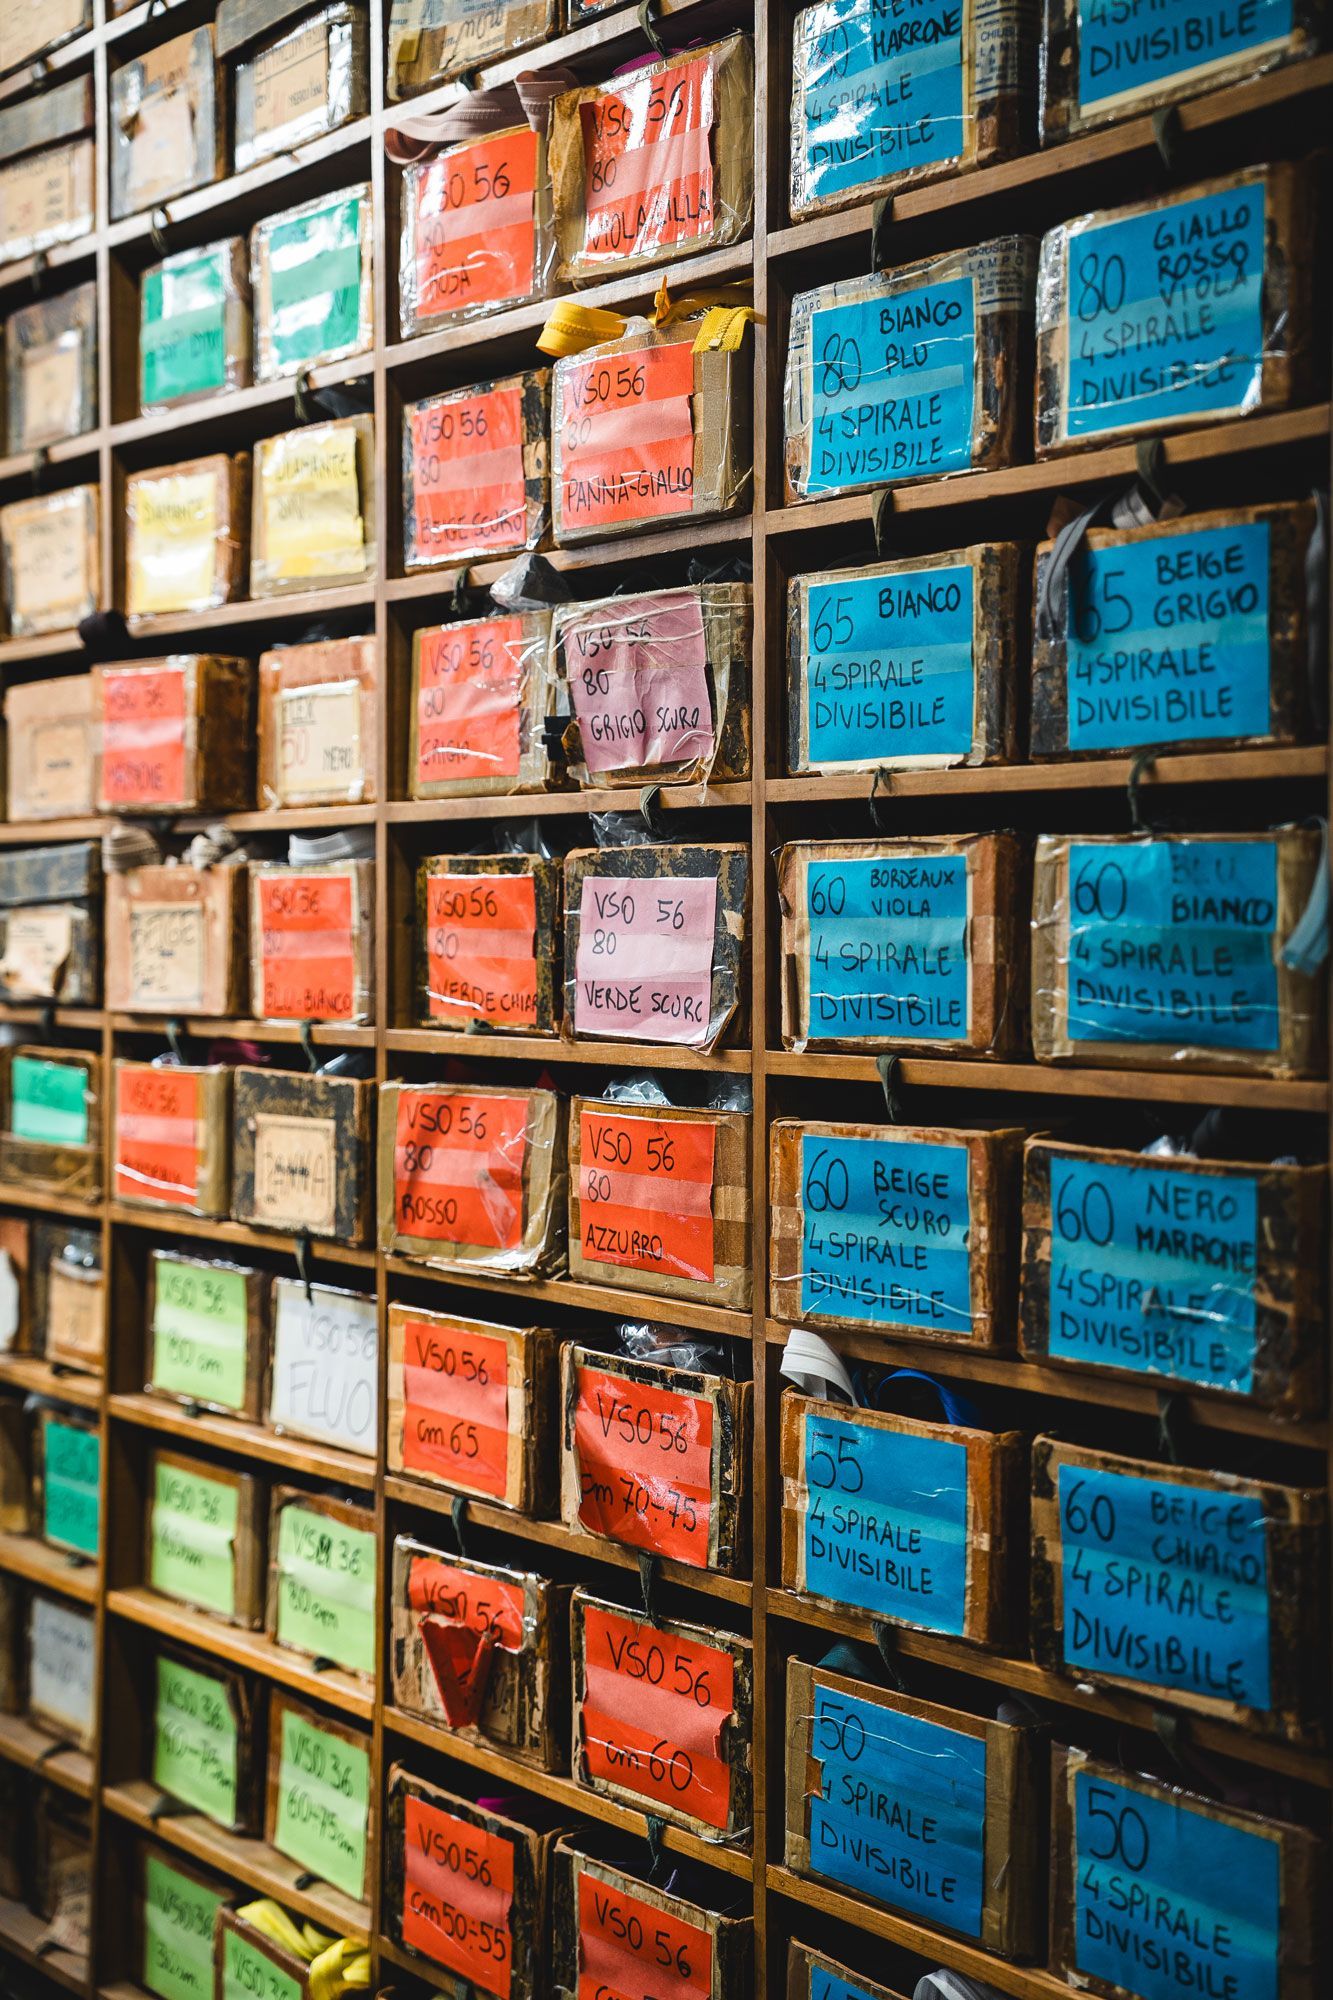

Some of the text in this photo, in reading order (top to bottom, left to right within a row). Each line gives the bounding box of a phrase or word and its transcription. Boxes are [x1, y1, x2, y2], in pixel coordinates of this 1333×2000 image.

[872, 8, 961, 62] MARRONE
[1090, 2, 1257, 77] DIVISIBILE
[829, 73, 912, 120] SPIRALE
[812, 113, 935, 164] DIVISIBILE
[473, 162, 511, 203] 56
[592, 157, 617, 193] 80
[592, 189, 711, 250] VIOLA ILLA
[1154, 204, 1250, 250] GIALLO
[1158, 240, 1249, 283] ROSSO
[1078, 252, 1125, 322] 80
[1159, 265, 1247, 308] VIOLA
[880, 298, 962, 334] BIANCO
[1080, 304, 1215, 366] 4 SPIRALE
[823, 333, 861, 398] 80
[885, 343, 928, 374] BLU
[1082, 348, 1235, 407] DIVISIBILE
[570, 365, 645, 409] VSO 56
[419, 409, 489, 445] VSO 56
[567, 417, 592, 451] 80
[819, 394, 942, 443] 4 SPIRALE
[418, 454, 441, 486] 80
[820, 437, 943, 475] DIVISIBILE
[471, 509, 523, 538] SCURO
[1156, 544, 1244, 585] BEIGE
[813, 583, 961, 652] 65 BIANCO
[1154, 582, 1259, 627] GRIGIO
[430, 638, 494, 675] VSO 56
[575, 627, 612, 657] VSO
[1096, 642, 1216, 684] SPIRALE
[582, 667, 610, 696] 80
[831, 659, 924, 691] SPIRALE
[424, 686, 446, 718] 80
[590, 706, 700, 742] GRIGIO SCURO
[815, 696, 945, 729] DIVISIBILE
[1077, 686, 1233, 726] DIVISIBILE
[433, 886, 499, 918] VSO 56
[594, 891, 685, 930] VSO 56
[811, 868, 955, 916] 60 BORDEAUX
[871, 899, 931, 917] VIOLA
[1075, 859, 1127, 921] 60
[1171, 893, 1274, 926] BIANCO
[434, 927, 459, 960] 80
[592, 928, 617, 955] 80
[815, 935, 952, 976] 4 SPIRALE
[1075, 932, 1234, 977] 4 SPIRALE
[436, 978, 496, 1013] VERDE
[585, 980, 643, 1014] VERDE
[820, 990, 961, 1027] DIVISIBILE
[1077, 977, 1251, 1024] DIVISIBILE
[406, 1101, 487, 1139] VSO 56
[404, 1140, 432, 1172] 80
[589, 1124, 675, 1171] VSO 56
[587, 1169, 611, 1202] 80
[806, 1149, 848, 1212] 60
[873, 1160, 949, 1198] BEIGE
[401, 1193, 458, 1225] ROSSO
[878, 1199, 950, 1236] SCURO
[1057, 1173, 1237, 1247] 60 NERO
[585, 1223, 663, 1261] AZZURRO
[828, 1232, 928, 1271] SPIRALE
[1135, 1223, 1256, 1274] MARRONE
[810, 1267, 945, 1318] DIVISIBILE
[1078, 1269, 1207, 1324] SPIRALE
[415, 1334, 489, 1385] VSO 56
[1060, 1311, 1226, 1373] DIVISIBILE
[289, 1360, 373, 1436] FLUO
[450, 1422, 479, 1458] 65
[597, 1393, 688, 1454] VSO 56
[811, 1431, 863, 1493] 55
[832, 1505, 921, 1554] SPIRALE
[1065, 1480, 1115, 1542] 60
[811, 1534, 933, 1594] DIVISIBILE
[1071, 1548, 1235, 1624] 4 SPIRALE
[423, 1578, 467, 1621] VSO
[606, 1631, 711, 1707] VSO 56
[1072, 1607, 1247, 1700] DIVISIBILE
[819, 1702, 865, 1761] 50
[650, 1740, 692, 1791] 60
[840, 1774, 937, 1843] SPIRALE
[1088, 1787, 1148, 1872] 50
[418, 1823, 492, 1887] VSO 56
[821, 1820, 957, 1903] DIVISIBILE
[595, 1892, 692, 1978] VSO 56
[1108, 1876, 1231, 1958] SPIRALE
[1085, 1907, 1238, 2000] DIVISIBILE
